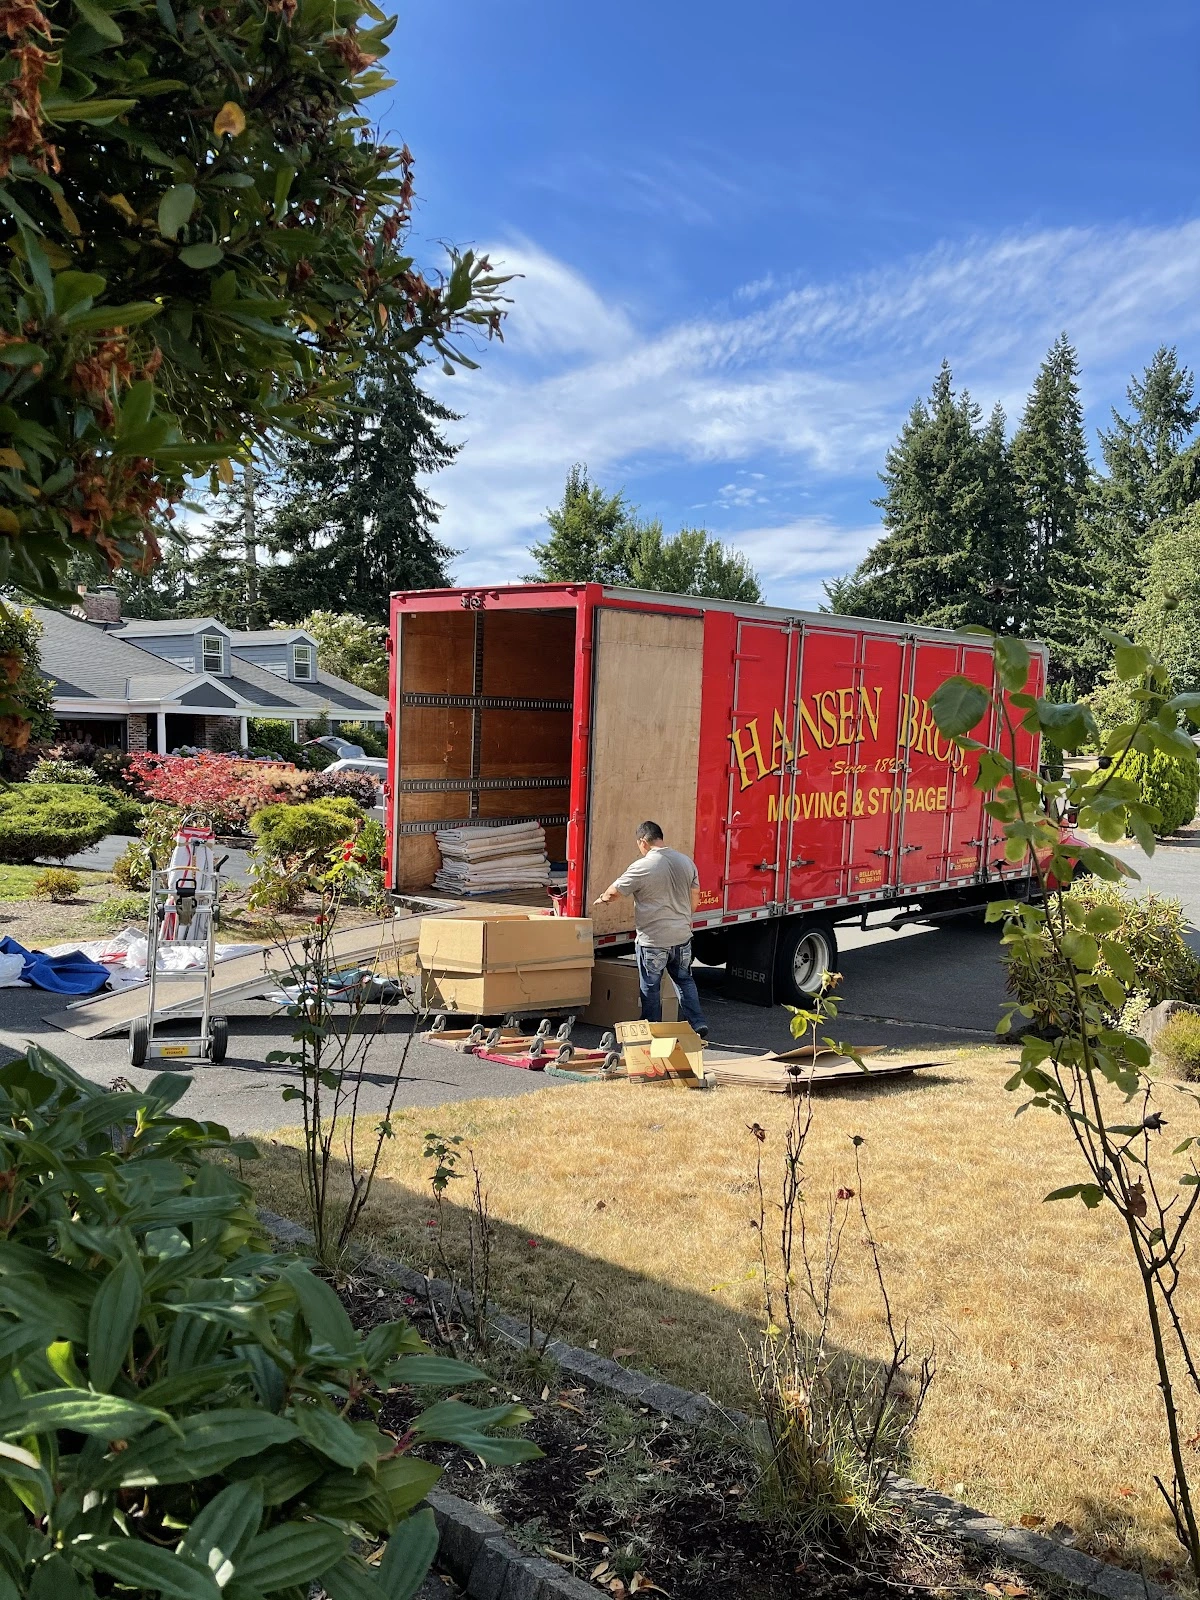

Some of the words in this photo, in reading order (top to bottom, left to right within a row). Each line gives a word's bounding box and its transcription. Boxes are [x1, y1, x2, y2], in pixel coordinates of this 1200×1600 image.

[727, 686, 883, 791] HANSEN
[831, 760, 867, 775] Since
[767, 790, 847, 822] MOVING
[852, 788, 865, 816] &
[867, 786, 948, 816] STORAGE
[731, 965, 766, 984] HEISER
